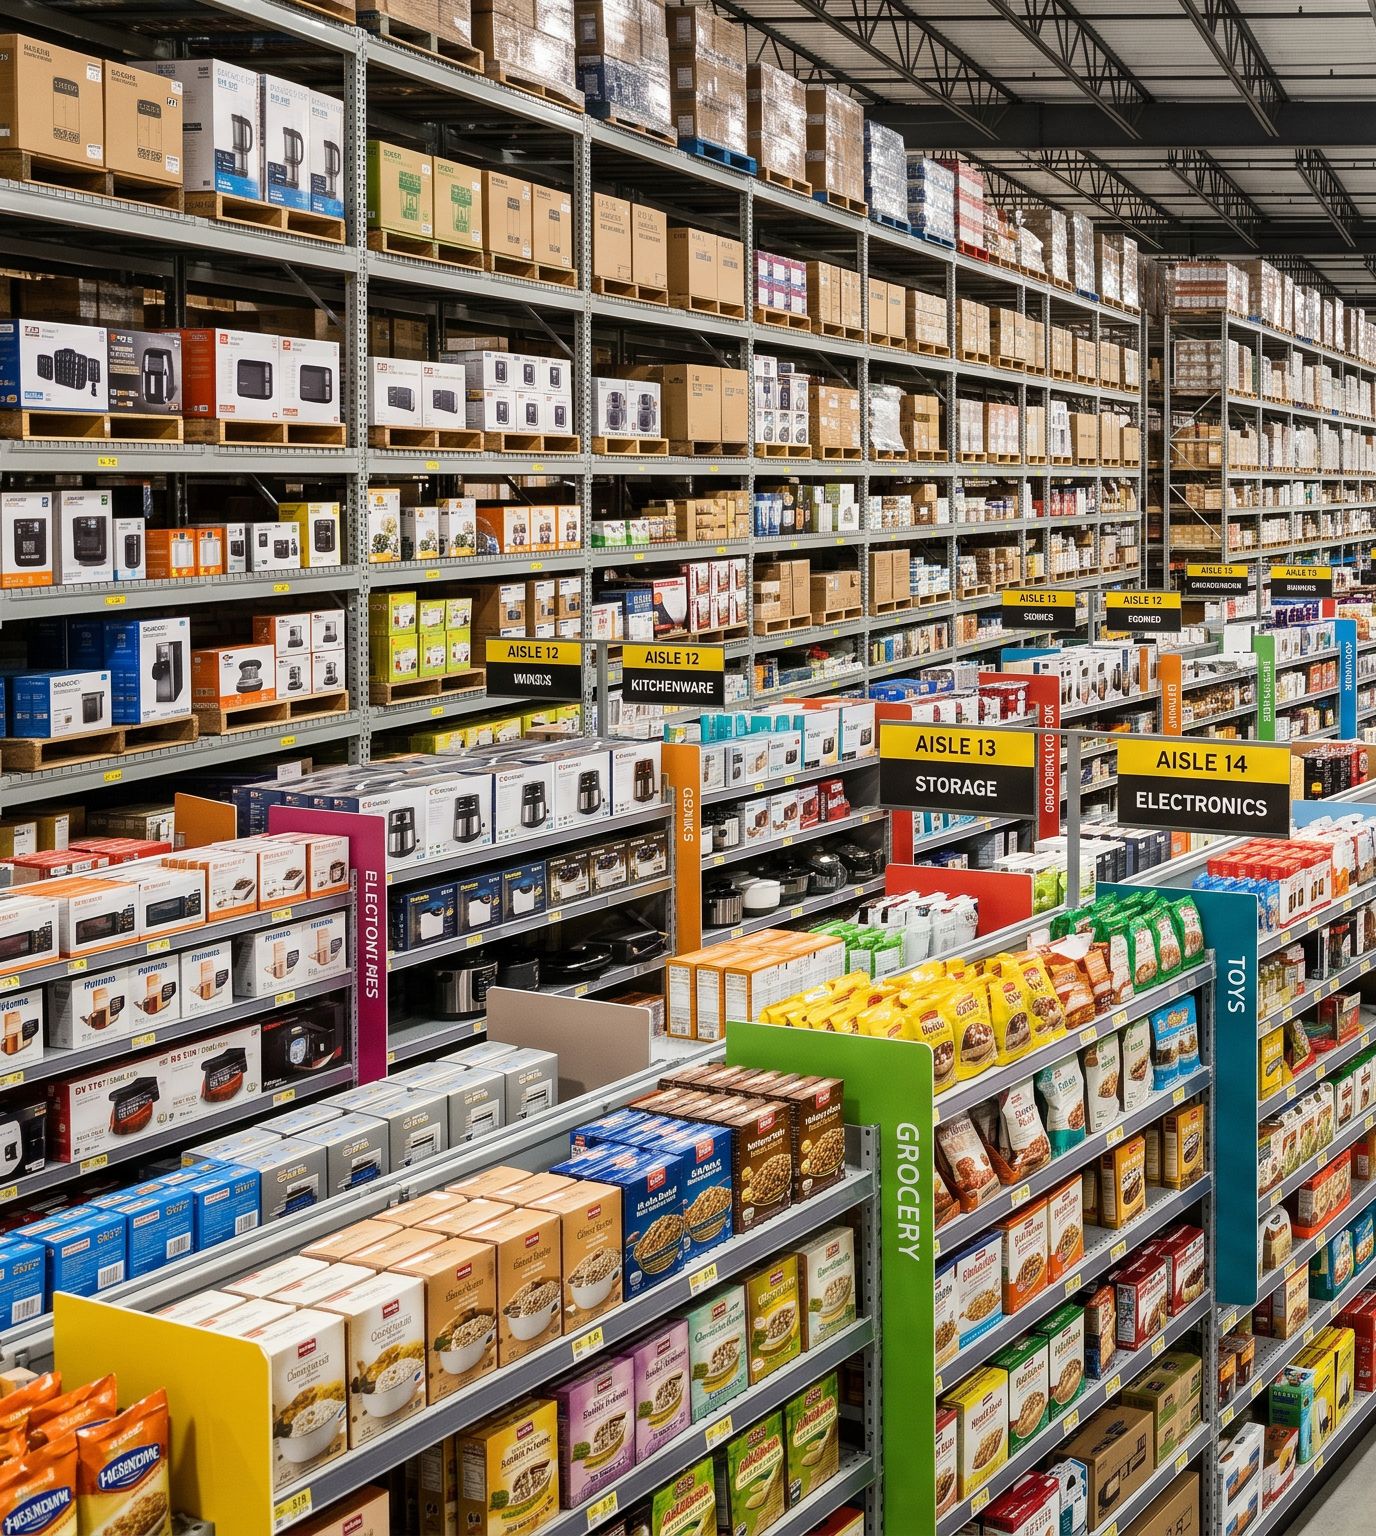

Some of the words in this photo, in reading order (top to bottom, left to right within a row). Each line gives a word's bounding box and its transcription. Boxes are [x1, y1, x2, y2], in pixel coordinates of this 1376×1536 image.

[1200, 566, 1222, 574] AISLE
[1020, 594, 1045, 603] AISLE
[1048, 594, 1057, 603] 13
[1123, 596, 1150, 604] AISLE
[1152, 596, 1162, 604] 12
[507, 645, 542, 659] AISLE
[546, 646, 559, 659] 12
[645, 651, 682, 664] AISLE
[685, 652, 699, 664] 12
[631, 678, 714, 694] KITCHENWARE
[915, 735, 970, 755] AISLE
[978, 738, 996, 756] 13
[1156, 750, 1217, 772] AISLE
[1225, 754, 1248, 773] 14
[915, 775, 998, 797] STORAGE
[1136, 791, 1268, 817] ELECTRONICS
[1228, 956, 1246, 1013] TOYS
[896, 1122, 920, 1262] GROCERY
